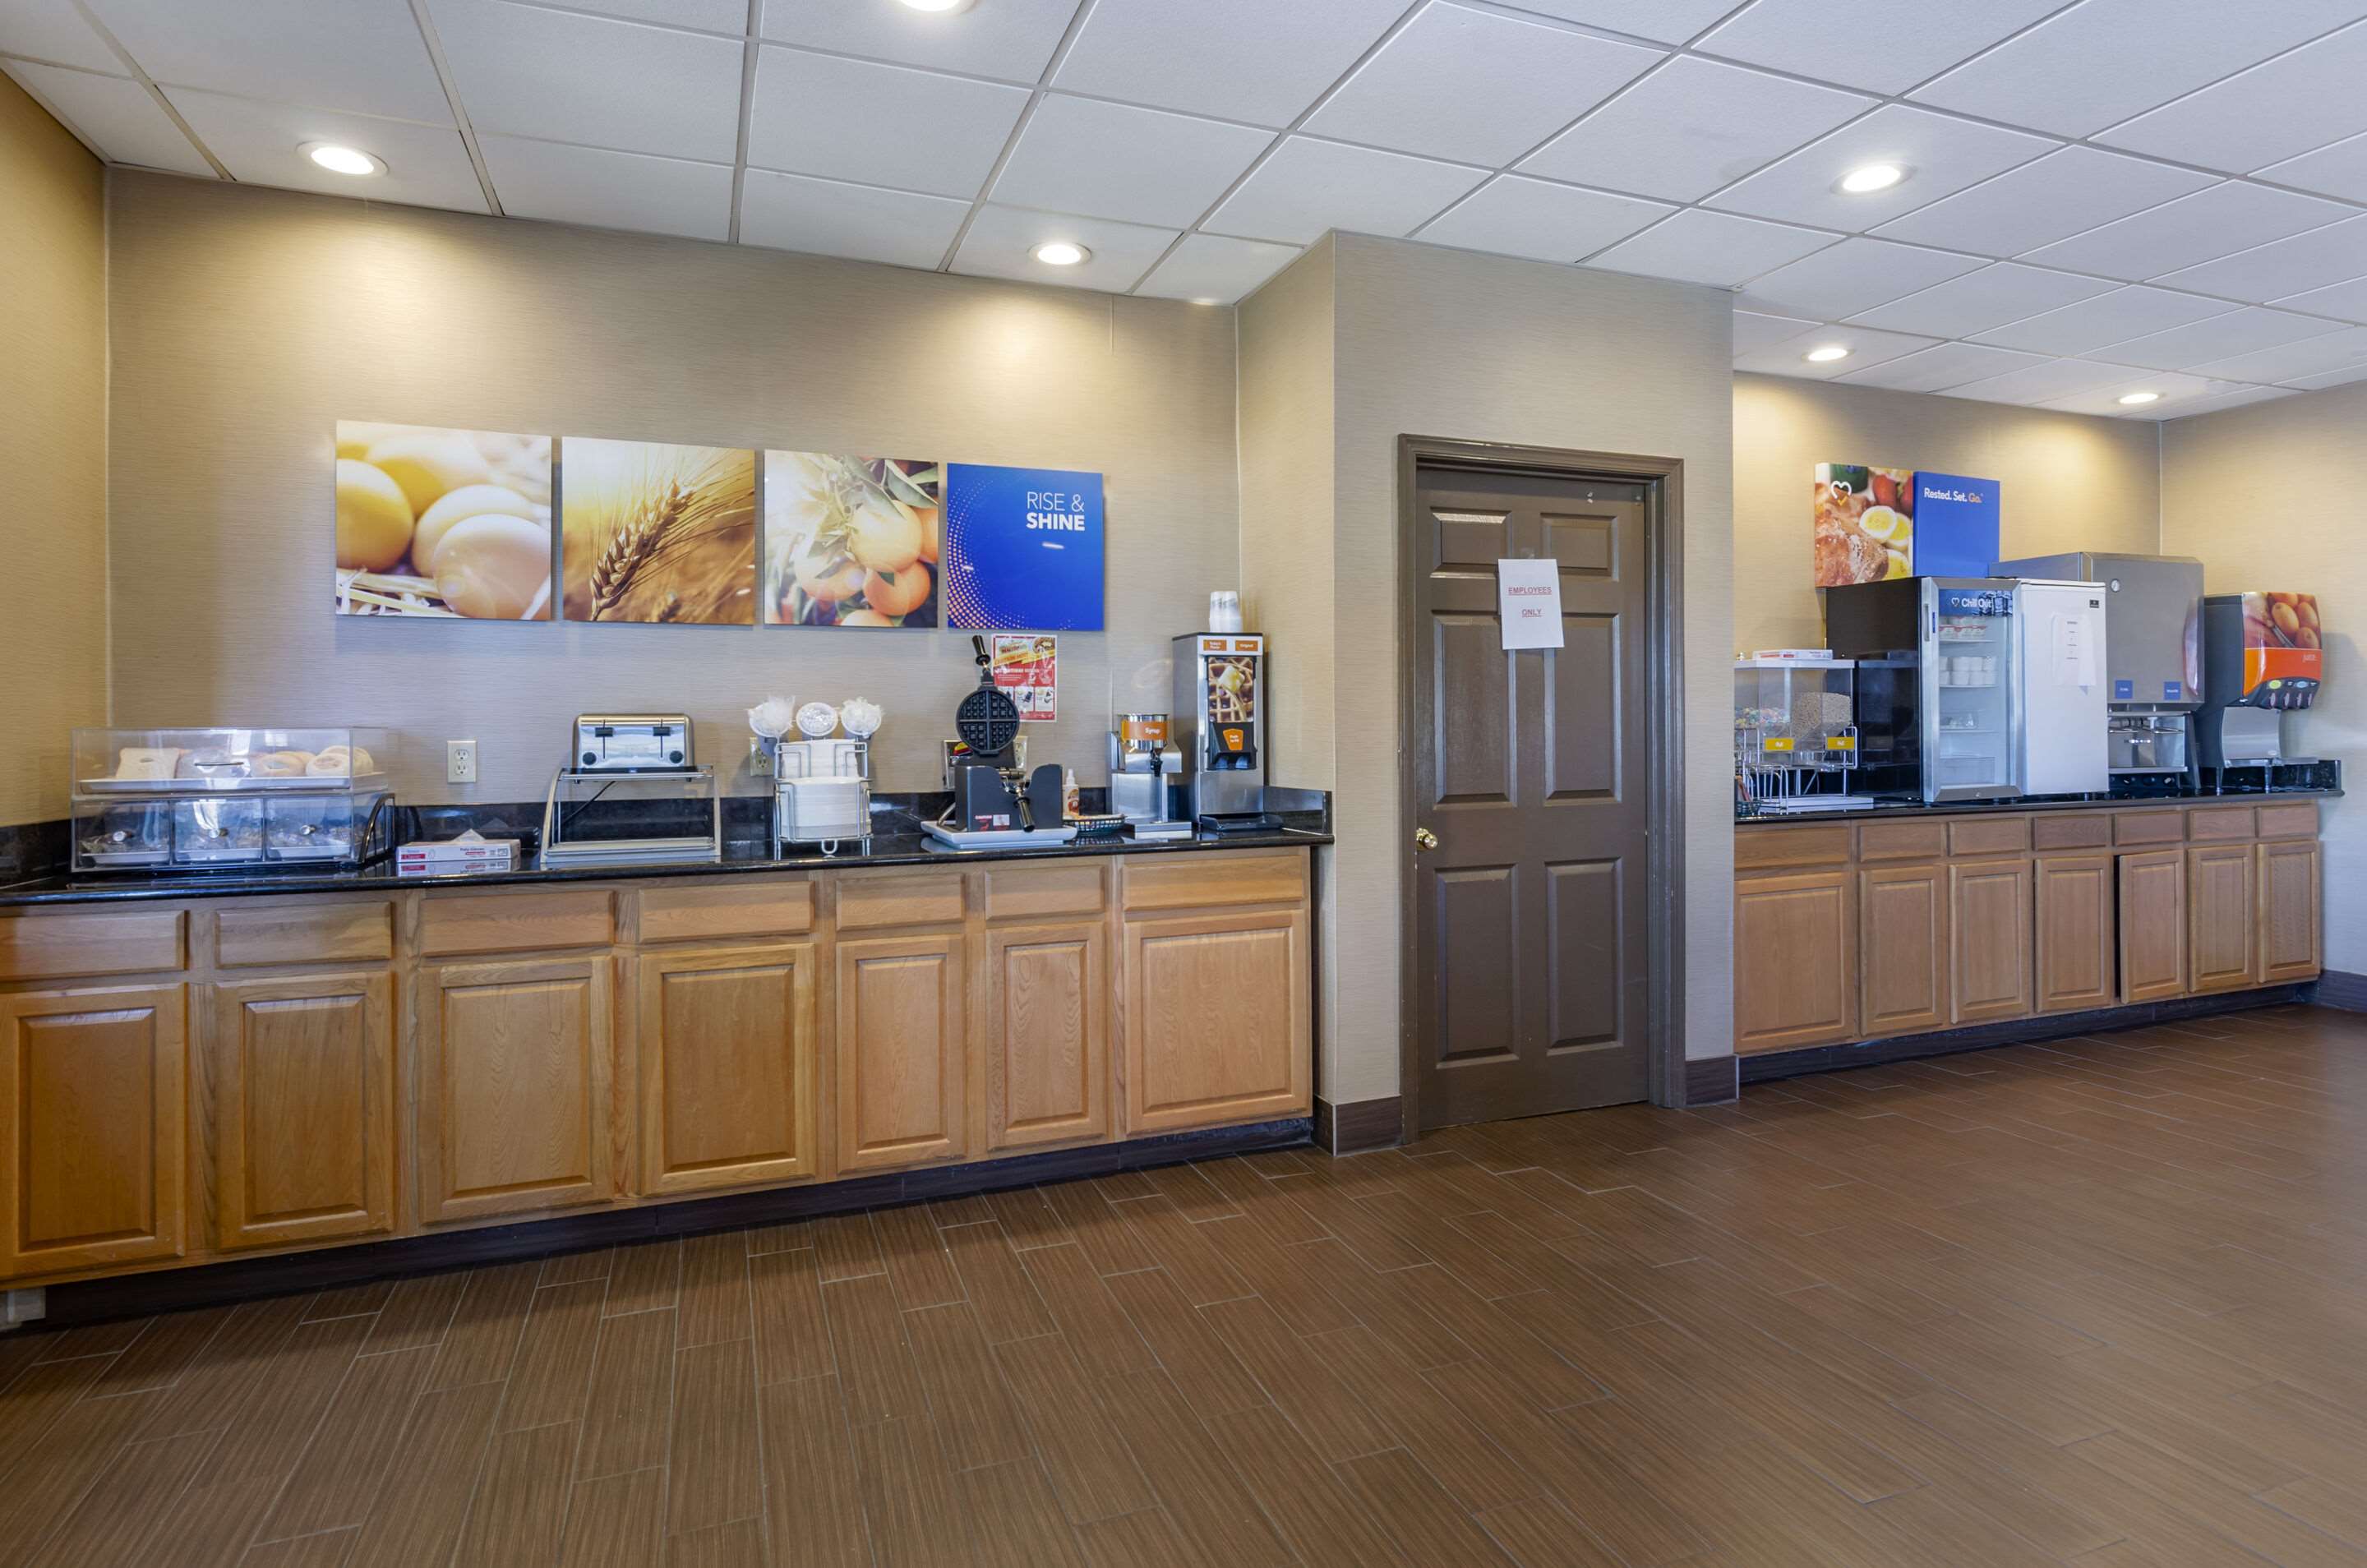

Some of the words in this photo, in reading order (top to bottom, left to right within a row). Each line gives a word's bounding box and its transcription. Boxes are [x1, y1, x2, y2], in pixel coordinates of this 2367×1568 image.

[1924, 487, 1952, 500] Rested.
[1953, 491, 1968, 502] Set.
[1027, 491, 1065, 511] RISE
[1071, 494, 1085, 512] &
[1026, 512, 1085, 531] SHINE
[1508, 586, 1552, 594] EMPLOYEES
[1961, 597, 1977, 608] Chill
[1978, 598, 1992, 608] Out
[1521, 608, 1542, 616] ONLY
[1145, 726, 1161, 735] Syrup
